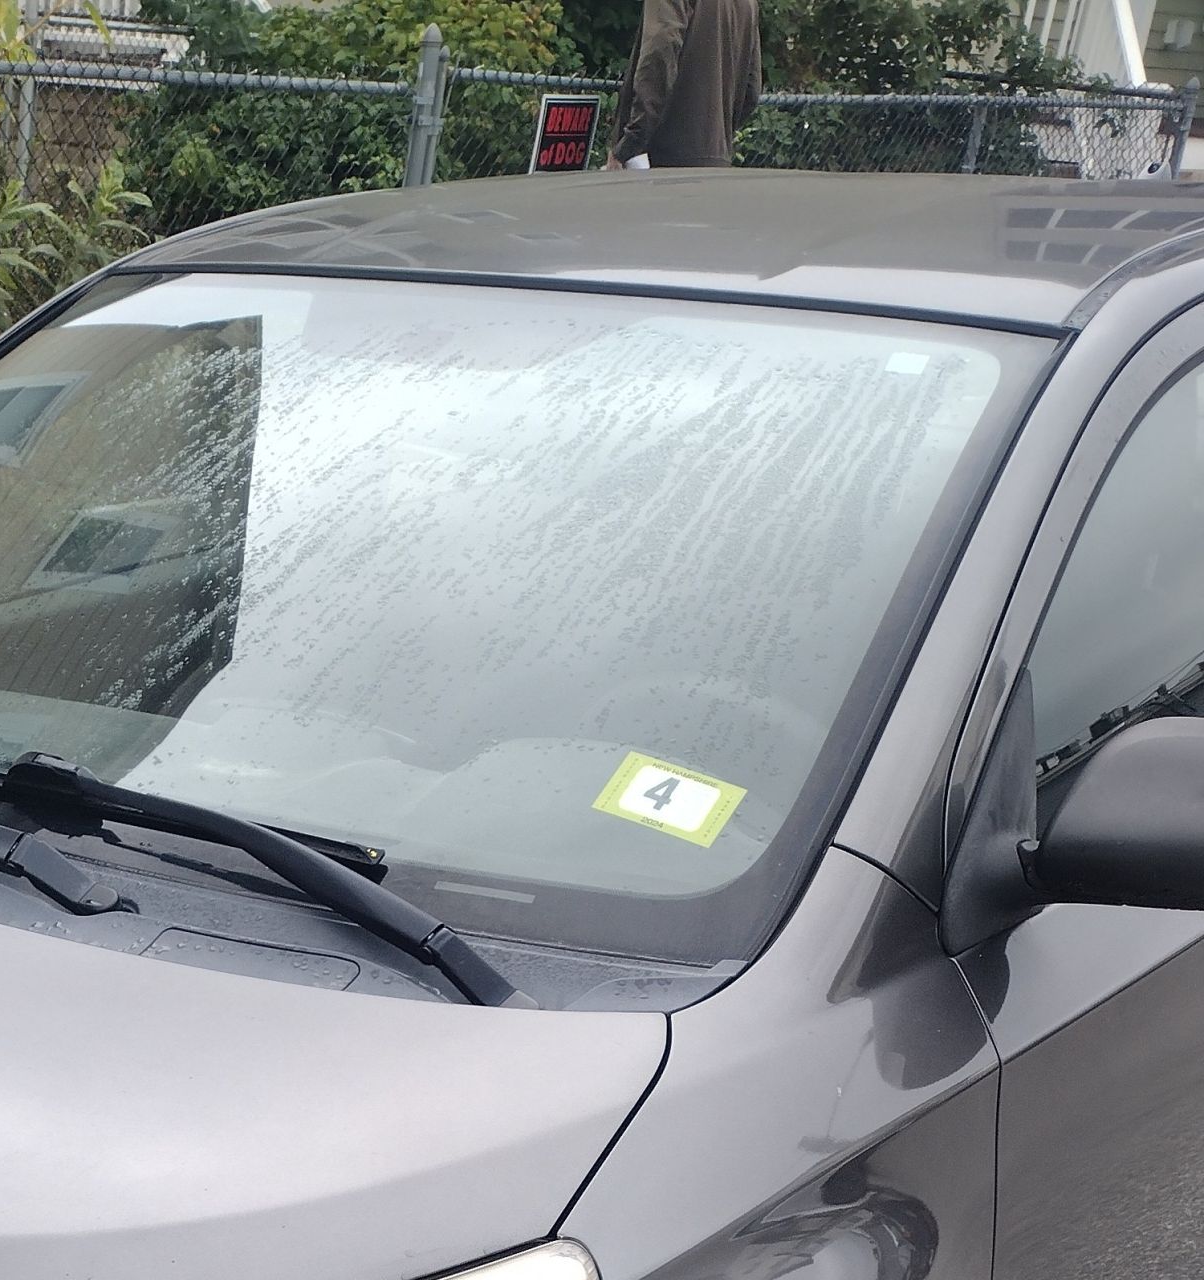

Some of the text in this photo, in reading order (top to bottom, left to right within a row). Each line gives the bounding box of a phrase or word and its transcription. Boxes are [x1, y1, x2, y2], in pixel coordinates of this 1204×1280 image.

[546, 106, 593, 132] BEWARE
[540, 141, 586, 166] of DOG
[643, 777, 681, 811] 4
[640, 816, 665, 829] 2024
